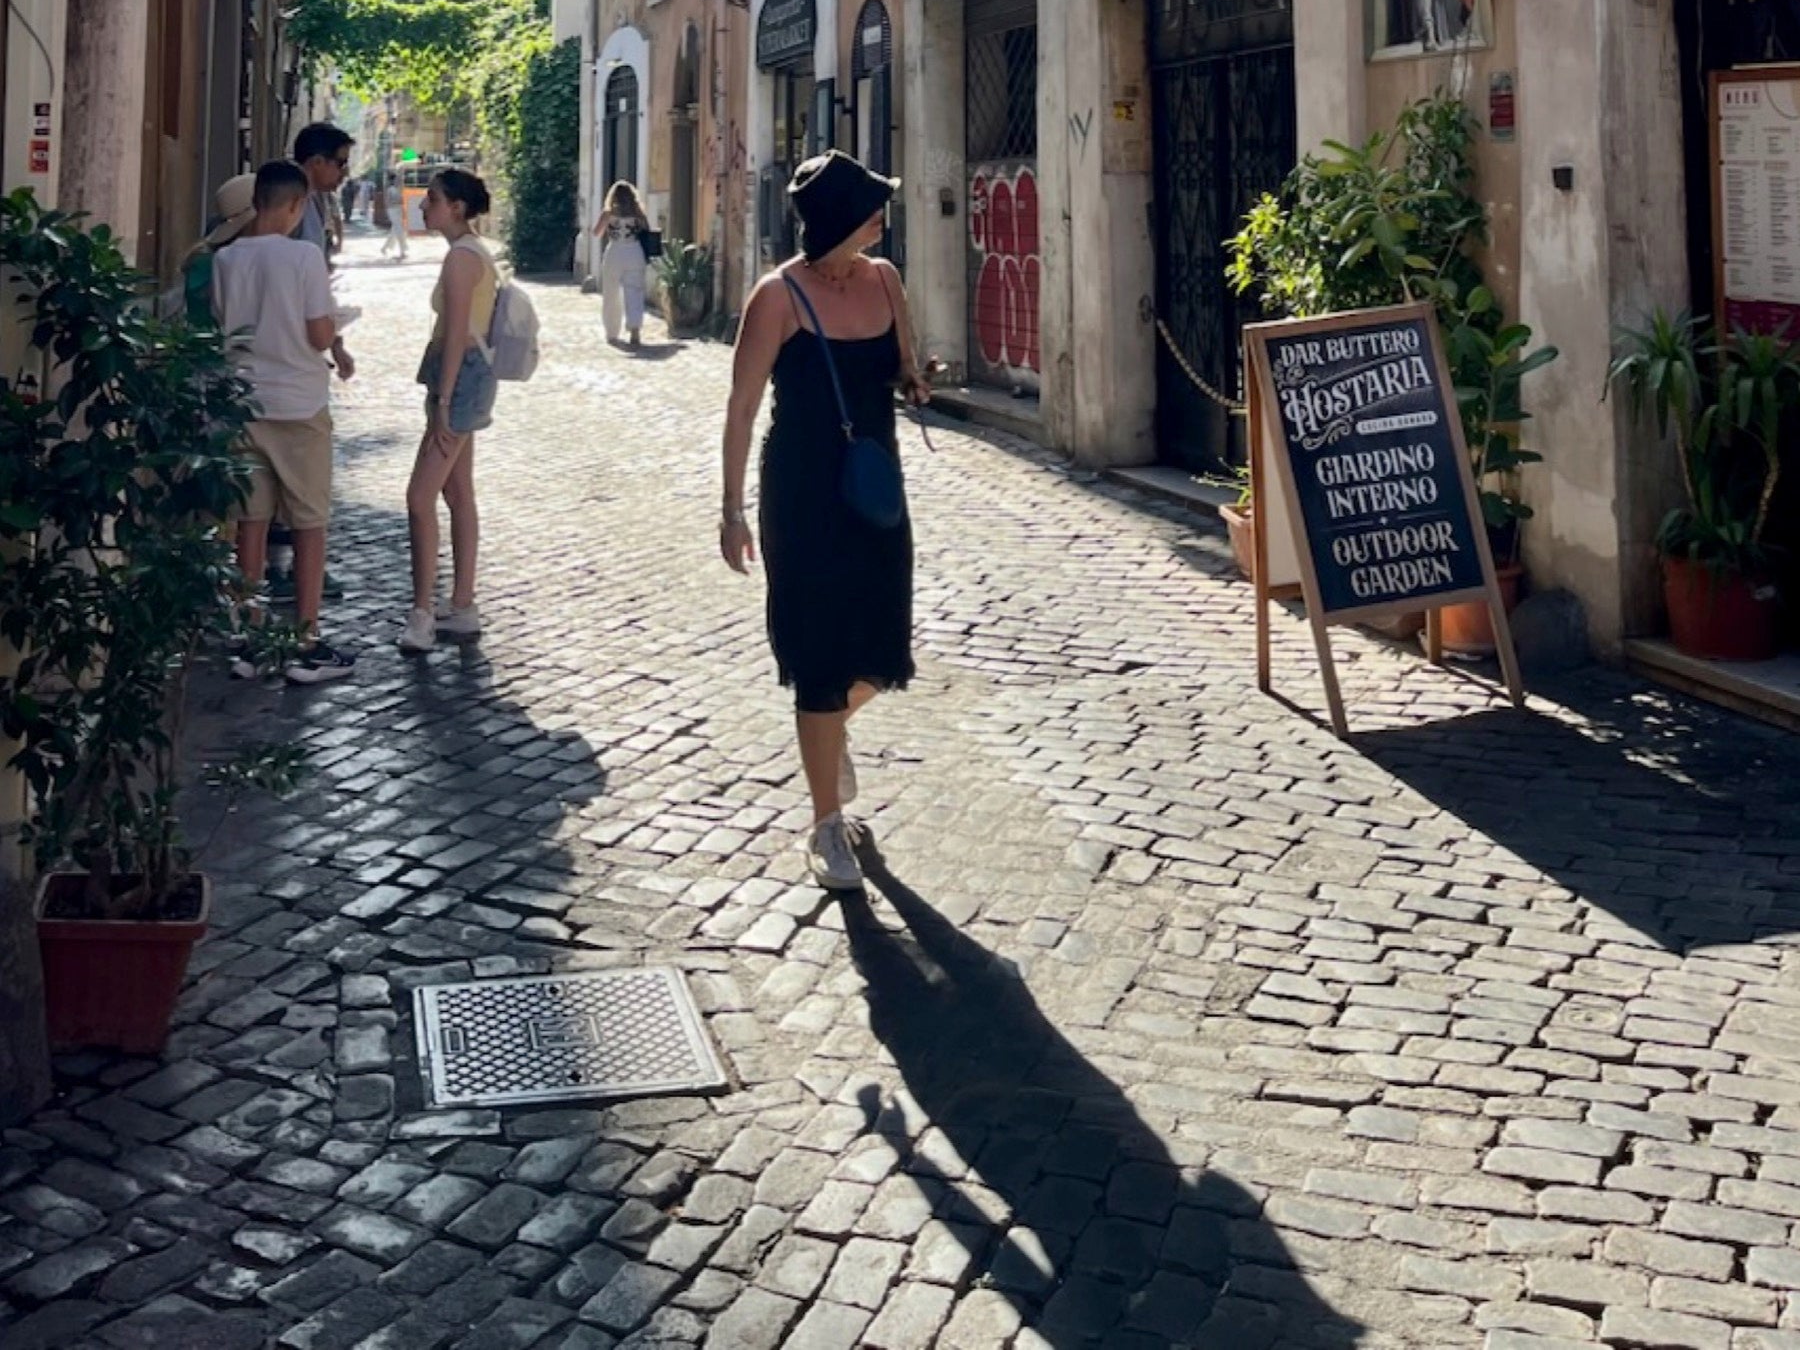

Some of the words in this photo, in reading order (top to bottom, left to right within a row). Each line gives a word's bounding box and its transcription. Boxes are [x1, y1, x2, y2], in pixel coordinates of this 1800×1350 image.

[1279, 341, 1325, 367] DAR
[1325, 328, 1420, 362] BUTTERO
[1280, 356, 1432, 442] HOSTARIA
[1315, 442, 1435, 486] GIARDINO
[1326, 476, 1437, 519] INTERNO
[1332, 521, 1459, 566] OUTDOOR
[1351, 554, 1453, 598] GARDEN
